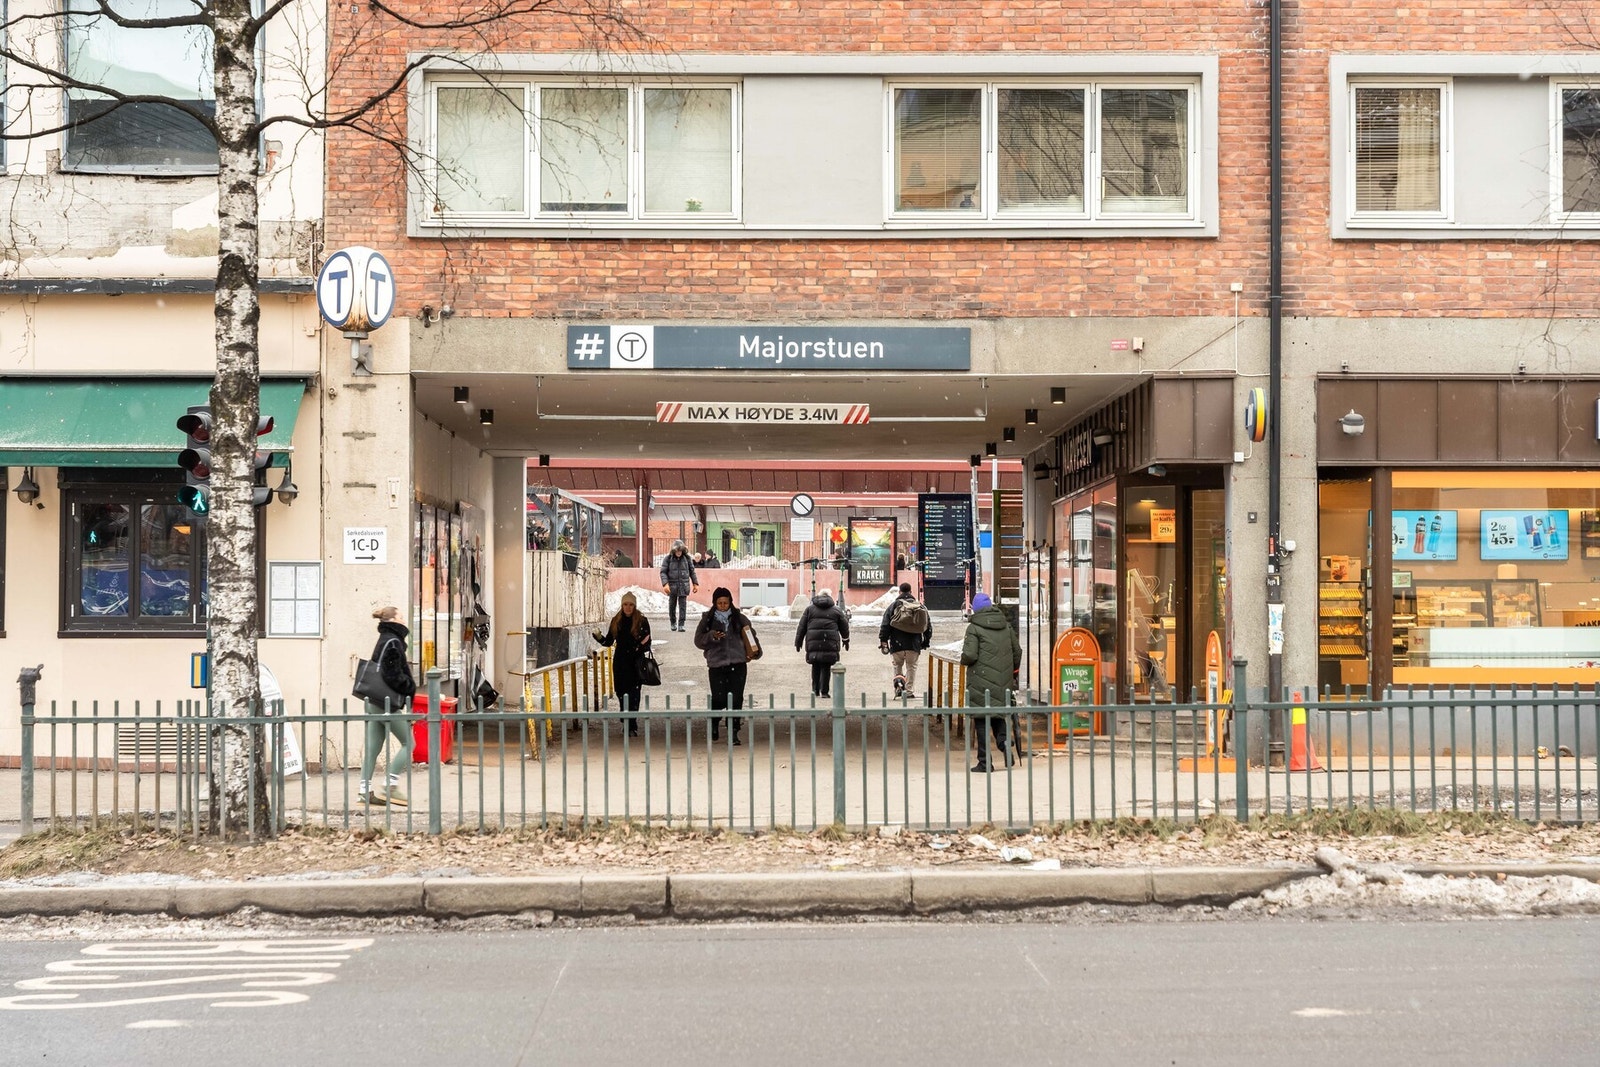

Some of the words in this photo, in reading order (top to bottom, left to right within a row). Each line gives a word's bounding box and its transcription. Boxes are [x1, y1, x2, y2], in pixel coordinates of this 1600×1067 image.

[328, 270, 348, 314] T
[370, 270, 386, 315] T
[739, 335, 884, 363] Majorstuen
[688, 407, 729, 420] MAX
[735, 407, 794, 421] HØYDE
[799, 408, 838, 421] 3.4M
[1491, 522, 1498, 531] 2
[351, 538, 379, 551] 1C-D
[856, 570, 885, 580] KRAKEN
[1065, 668, 1088, 677] Wraps
